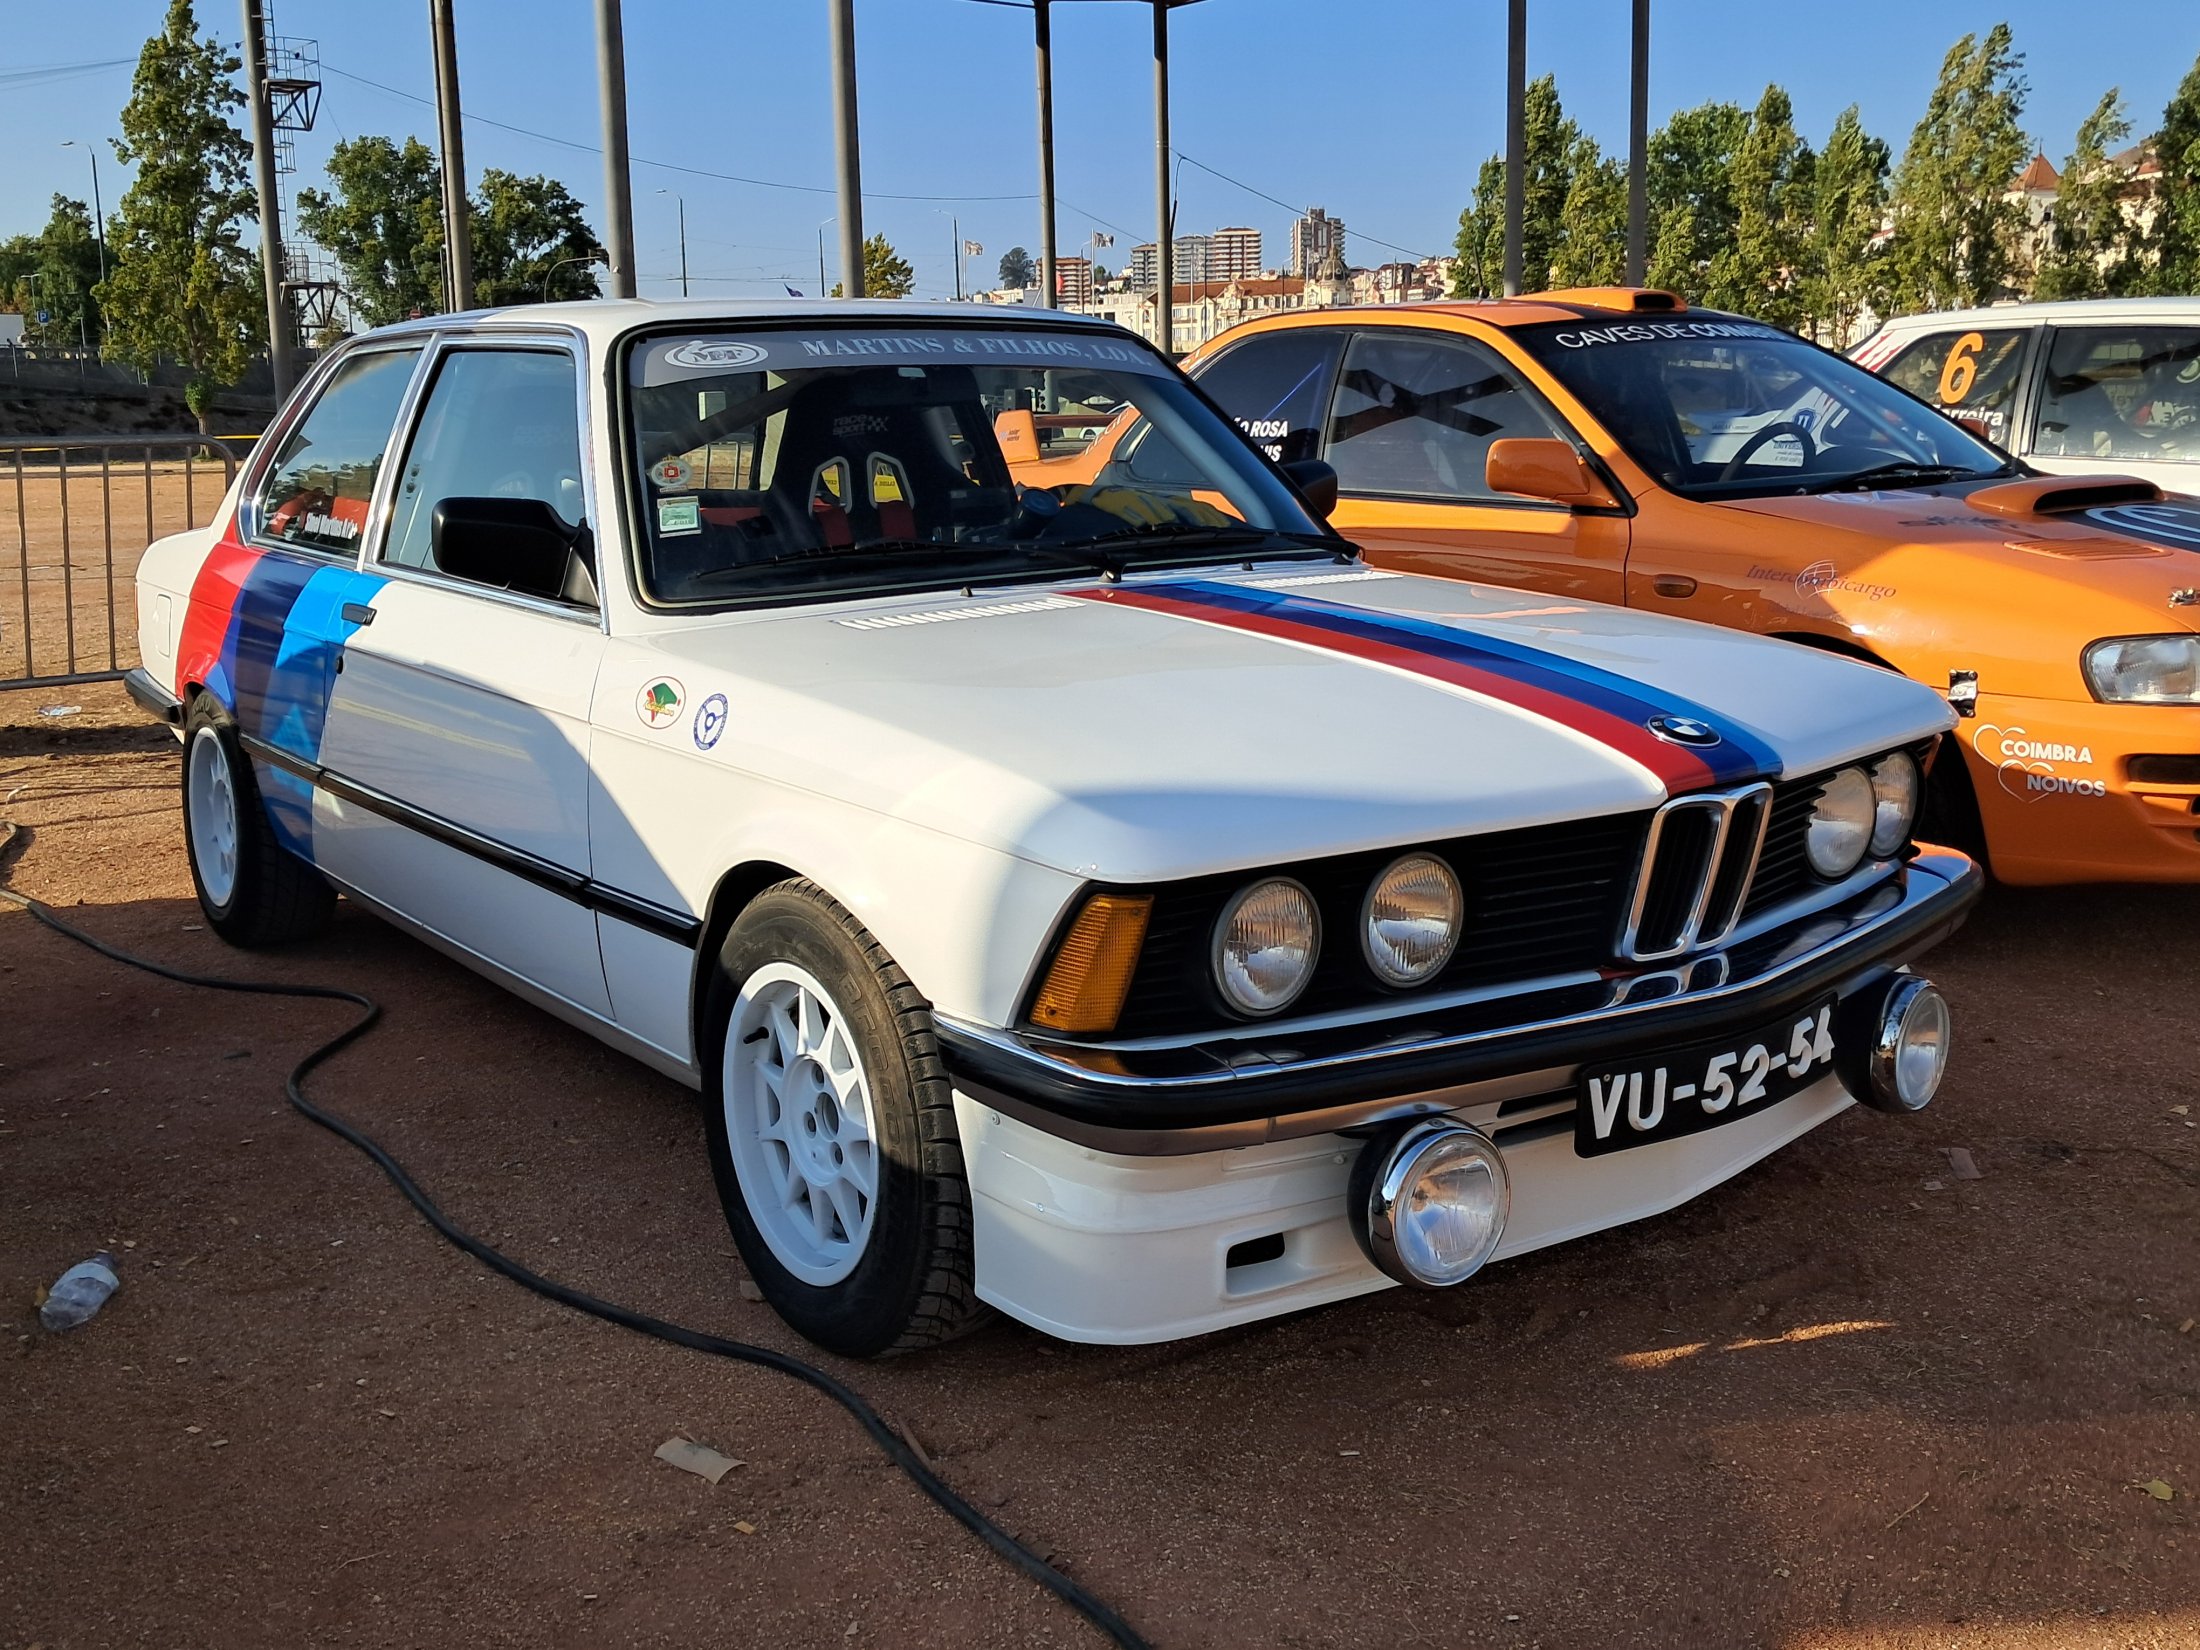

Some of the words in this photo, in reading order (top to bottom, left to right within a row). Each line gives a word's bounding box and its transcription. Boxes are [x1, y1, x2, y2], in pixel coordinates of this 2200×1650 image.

[40, 312, 47, 322] P
[1555, 325, 1656, 348] CAVES
[1648, 324, 1696, 338] DE
[1688, 323, 1788, 341] COIMB
[801, 337, 946, 358] MARTINS
[953, 337, 975, 354] &
[1091, 344, 1153, 367] LDA.
[1940, 332, 1983, 404] 6
[1249, 420, 1288, 437] ROSA
[2000, 739, 2093, 763] COIMBRA
[2027, 774, 2105, 797] NOIVOS
[1589, 1004, 1836, 1140] VU-52-54
